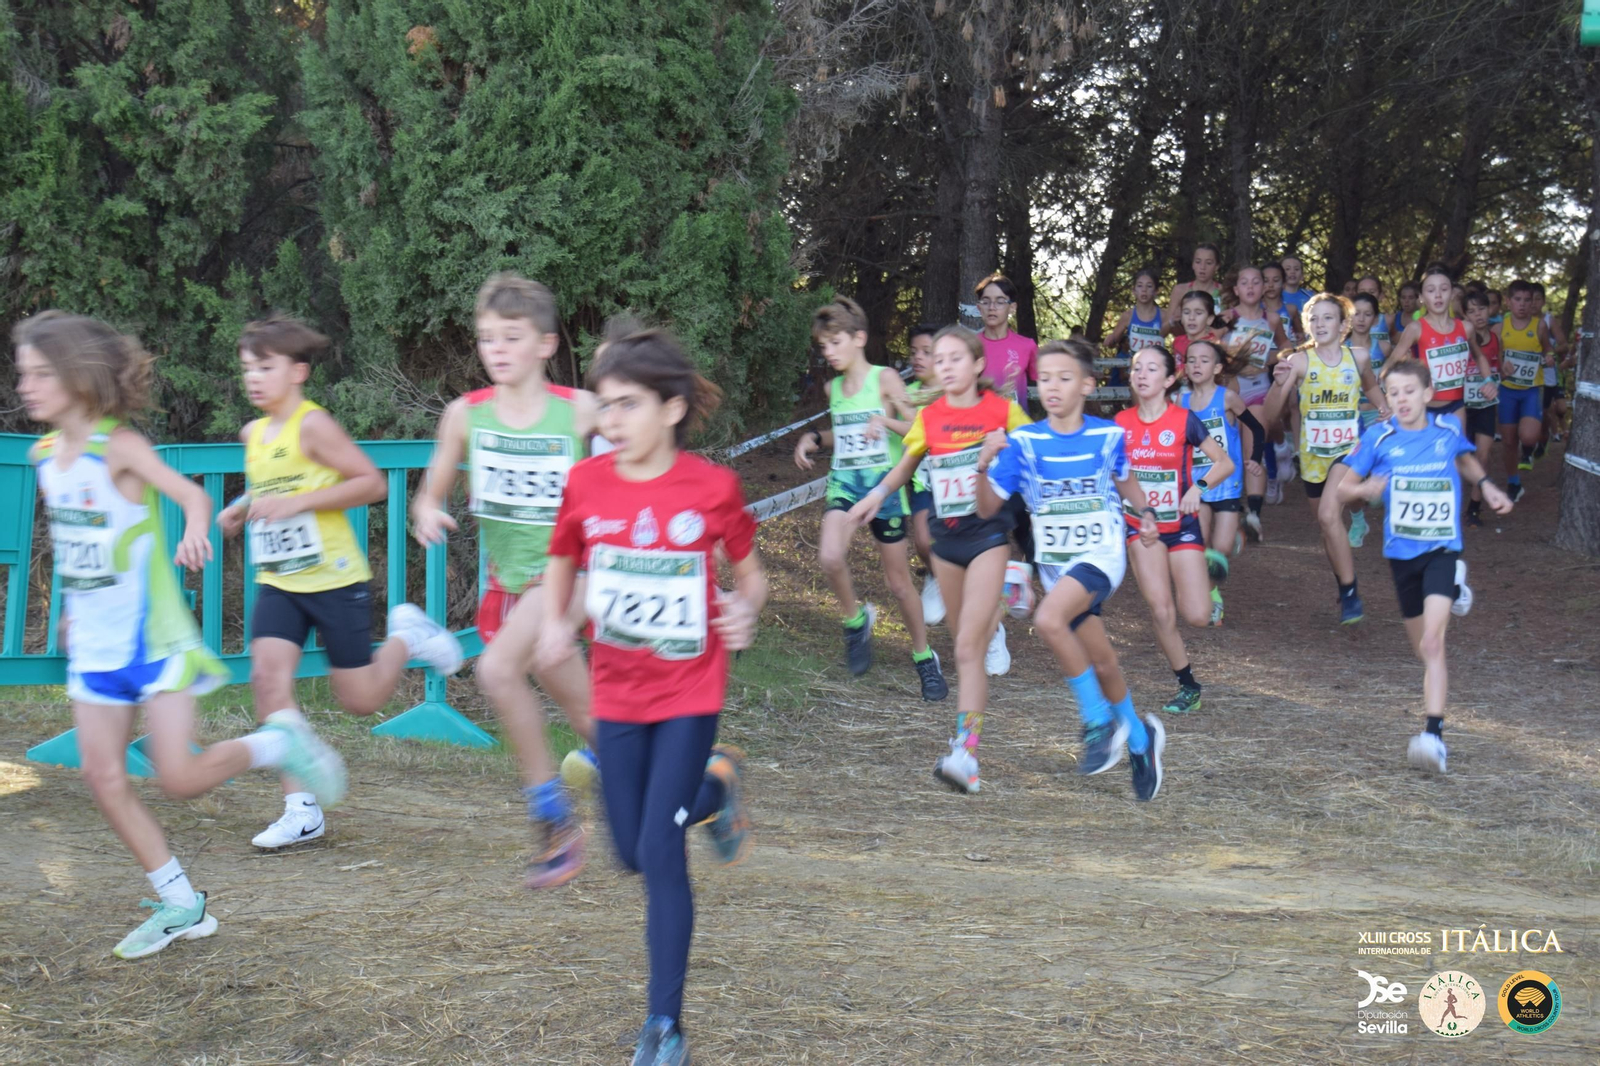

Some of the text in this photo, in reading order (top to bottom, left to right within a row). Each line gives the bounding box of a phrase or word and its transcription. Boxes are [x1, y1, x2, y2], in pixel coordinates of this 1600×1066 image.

[1434, 358, 1467, 379] 7083
[1512, 363, 1535, 377] 766
[1311, 427, 1355, 444] 7194
[481, 465, 564, 499] 7858
[938, 473, 979, 499] 713
[1148, 490, 1174, 508] 84
[1398, 501, 1451, 521] 7929
[1043, 522, 1103, 547] 5799
[599, 587, 698, 628] 7821
